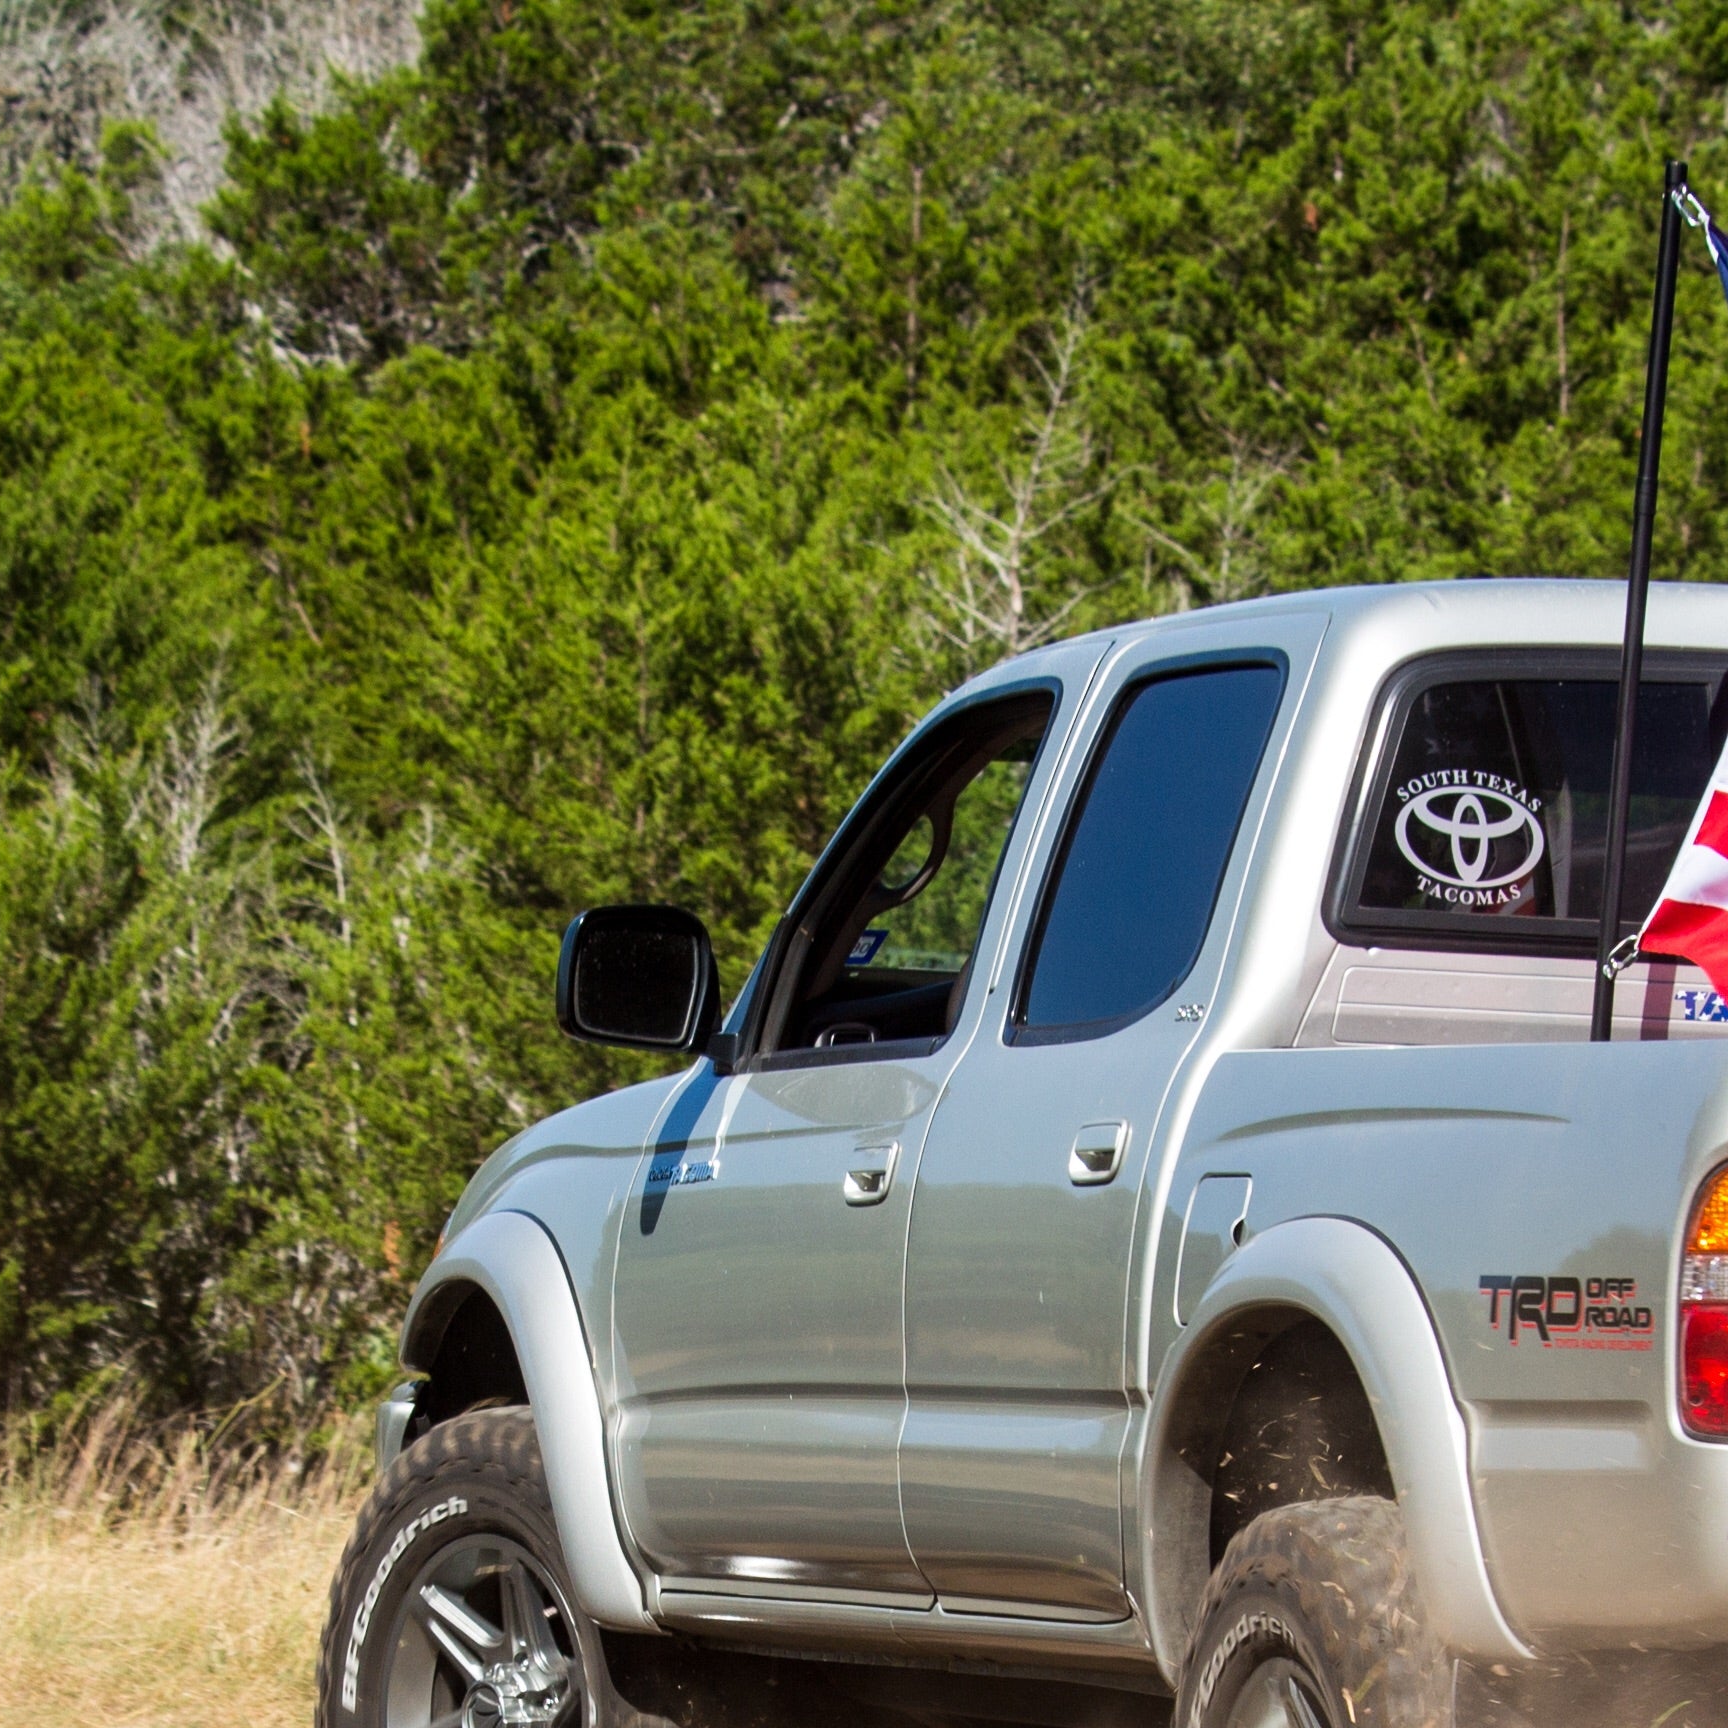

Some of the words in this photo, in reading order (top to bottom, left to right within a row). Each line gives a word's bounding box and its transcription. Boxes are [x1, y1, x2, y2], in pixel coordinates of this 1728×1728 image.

[1397, 769, 1469, 802] SOUTH
[1473, 770, 1542, 812] TEXAS
[1416, 874, 1521, 906] TACOMAS
[1586, 1278, 1637, 1303] OFF
[1479, 1275, 1584, 1347] TRD
[1585, 1307, 1655, 1334] ROAD
[342, 1496, 468, 1714] BFGoodrich
